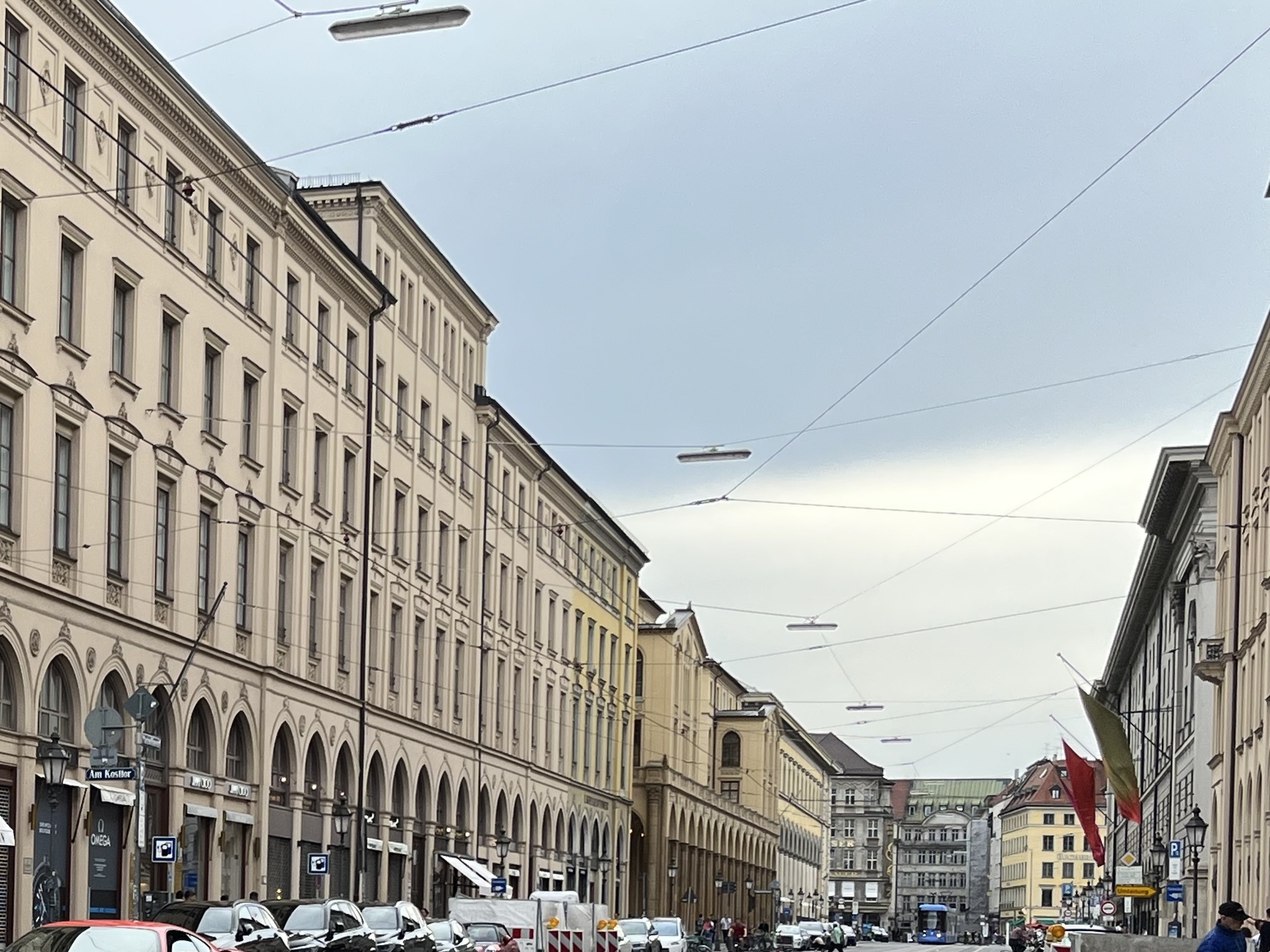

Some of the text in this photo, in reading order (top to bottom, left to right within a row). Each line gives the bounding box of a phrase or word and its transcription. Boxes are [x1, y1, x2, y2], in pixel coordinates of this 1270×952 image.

[89, 769, 103, 779] Am
[90, 833, 111, 847] OMEGA
[1170, 842, 1179, 856] P
[1117, 888, 1149, 896] Umleitung
